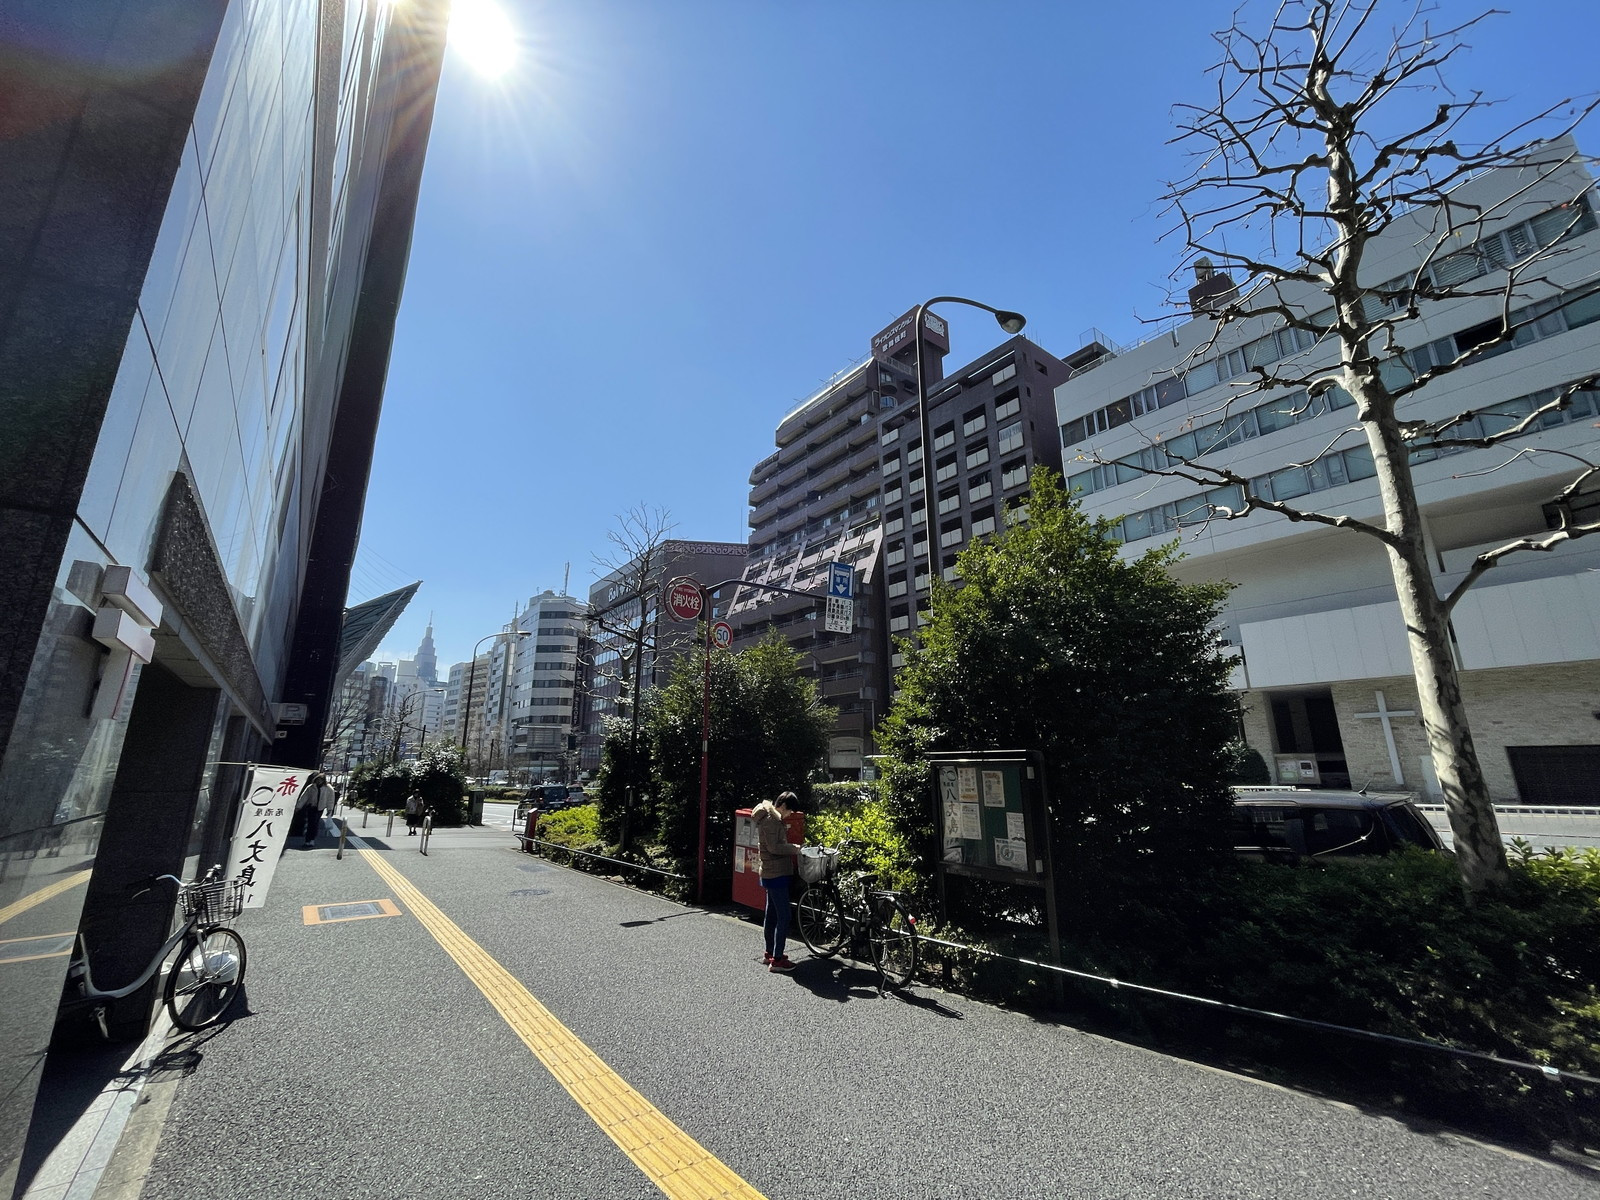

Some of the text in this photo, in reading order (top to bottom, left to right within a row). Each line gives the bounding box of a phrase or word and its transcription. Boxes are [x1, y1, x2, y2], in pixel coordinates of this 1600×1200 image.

[673, 592, 700, 610] 消火栓
[716, 629, 728, 642] 50
[945, 788, 959, 835] 八丈島
